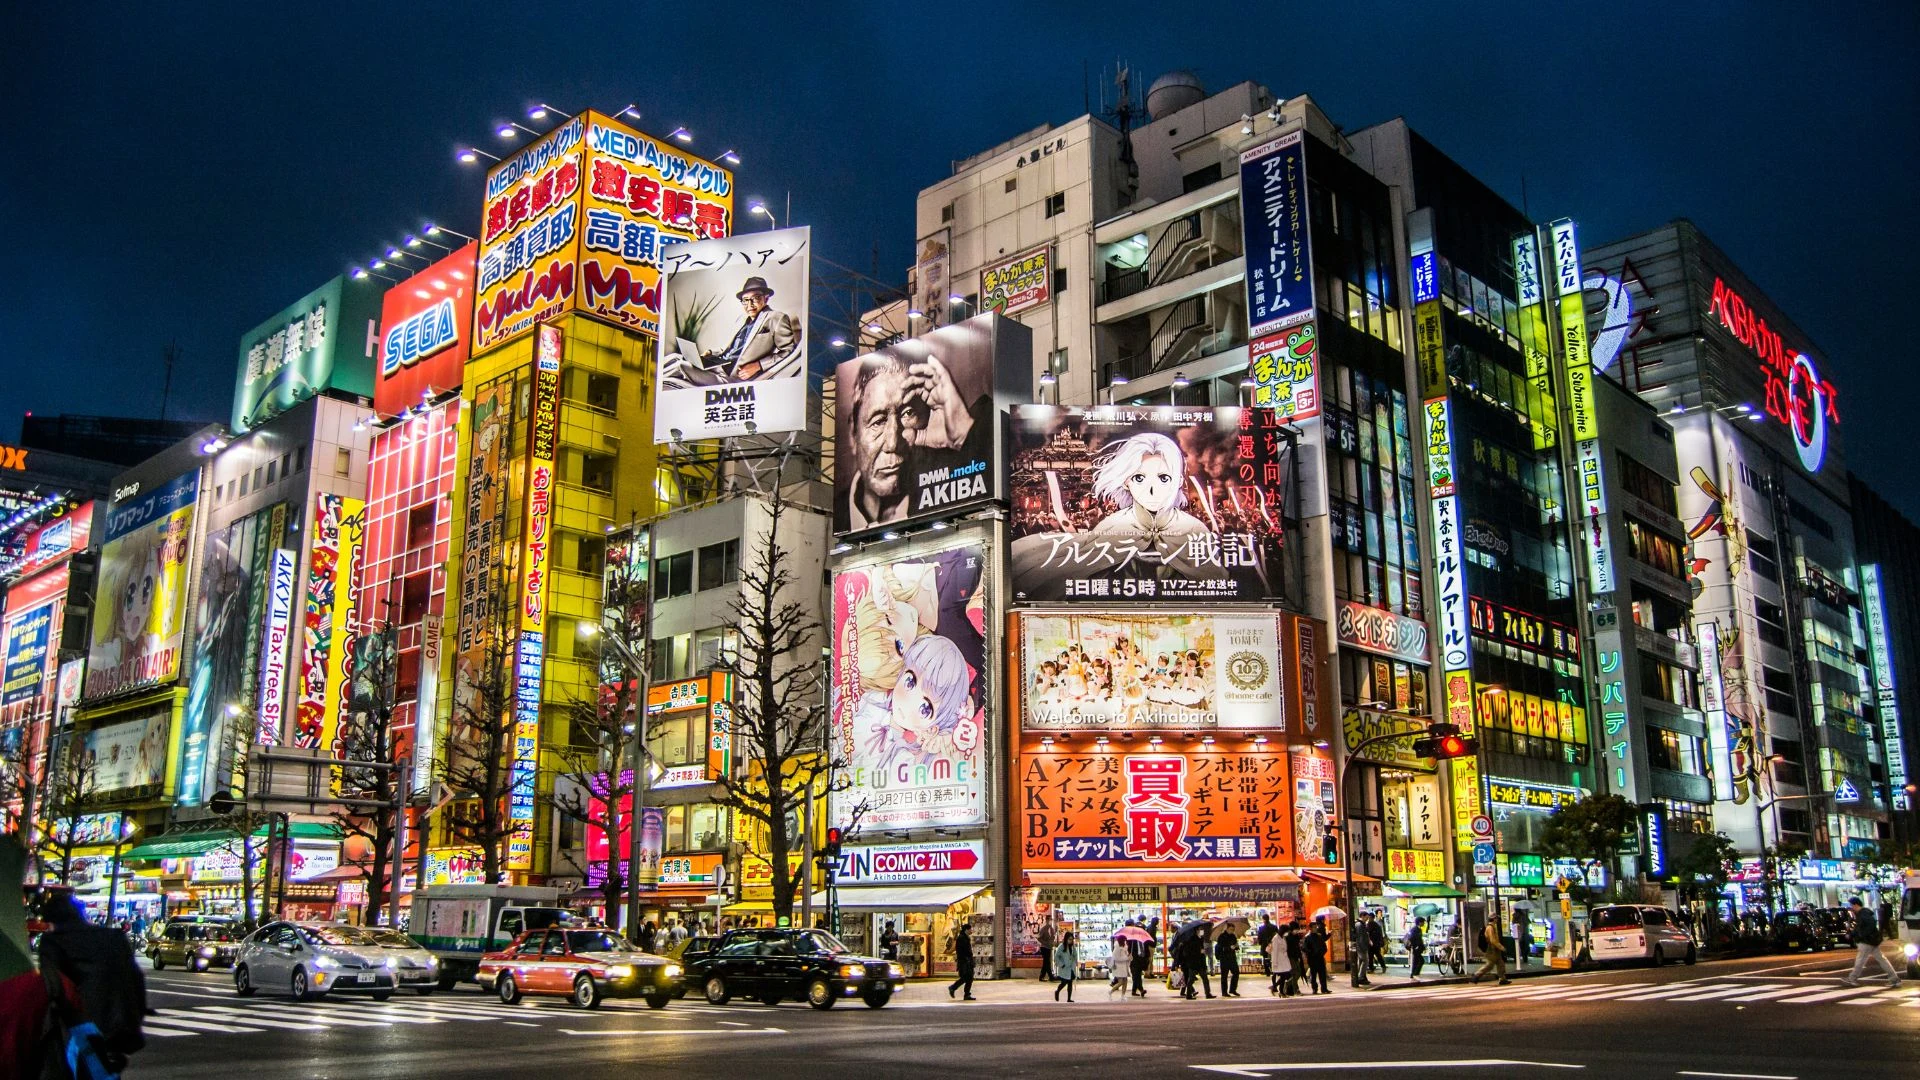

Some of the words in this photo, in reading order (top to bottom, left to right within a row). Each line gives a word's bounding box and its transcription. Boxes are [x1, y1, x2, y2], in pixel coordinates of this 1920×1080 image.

[488, 118, 584, 200] MEDIAリサイクル
[593, 124, 730, 197] MEDIAリサイクル
[1243, 145, 1271, 160] AMENITY
[1275, 134, 1298, 150] DREAM
[485, 153, 580, 243] 激安販売
[590, 159, 728, 241] 激安販売
[479, 202, 577, 295] 高額買取
[1262, 156, 1291, 312] アメニティードリーム
[985, 253, 1046, 293] まんが喫茶
[1557, 230, 1576, 288] スーパービル
[1254, 268, 1266, 317] 秋葉原店
[511, 317, 533, 334] AKIBA
[597, 304, 641, 325] ムーラン
[1254, 321, 1283, 335] AMENITY
[1287, 313, 1310, 326] DREAM
[382, 297, 459, 380] SEGA
[1566, 325, 1579, 362] Yellow
[540, 360, 558, 370] あなたの
[540, 372, 557, 384] DVD
[1253, 354, 1313, 383] まんが
[538, 391, 556, 403] ゲーム
[540, 402, 553, 411] CD
[705, 386, 755, 405] DMM
[1256, 381, 1291, 405] 喫茶
[1571, 371, 1587, 433] Submarine
[536, 420, 554, 432] アニメ
[704, 403, 755, 424] 英会話
[1173, 411, 1213, 422] 田中芳樹
[1428, 401, 1445, 445] まんが
[114, 482, 140, 503] Sofmap
[918, 473, 987, 510] AKIBA
[460, 454, 485, 652] 激安販売の専門店
[1039, 532, 1257, 572] アルスラーン戦記
[272, 552, 293, 608] AKKY
[475, 521, 493, 645] 高額買取と
[1075, 579, 1109, 596] 日曜
[1123, 578, 1156, 597] 5時
[1161, 579, 1237, 590] TVアニメ放送中
[1439, 556, 1464, 646] ルノアール
[427, 621, 440, 659] GAME
[1338, 605, 1427, 657] メイドカジノ
[1503, 611, 1545, 646] フィギュア
[263, 624, 287, 700] Tax-free
[670, 682, 698, 699] 吉野家
[1255, 692, 1272, 700] cafe
[1449, 676, 1472, 738] 免税
[1031, 708, 1107, 724] Welcome
[1111, 708, 1127, 724] to
[1133, 708, 1216, 724] Akihabara
[1600, 651, 1626, 788] リバティー
[1053, 757, 1074, 833] アイドル
[1076, 757, 1098, 813] アニメ
[1098, 757, 1120, 836] 美少女系
[1192, 757, 1214, 835] フィギュア
[1215, 757, 1236, 813] ホビー
[1237, 757, 1260, 835] 携帯電話
[1024, 758, 1051, 858] AKBもの
[1125, 757, 1190, 860] 買取
[1261, 757, 1285, 859] アップルとか
[1419, 795, 1432, 840] ルノアール
[1476, 821, 1488, 829] 40
[313, 854, 333, 862] Japan
[510, 843, 530, 851] AKIBA
[1055, 839, 1122, 859] チケット
[1194, 837, 1258, 859] 大黒屋
[1477, 848, 1486, 861] P
[1647, 812, 1660, 873] GALLERIA
[663, 858, 691, 875] 吉野家
[838, 848, 870, 880] ZIN
[873, 873, 917, 881] Akihabara
[875, 852, 926, 872] COMIC
[928, 851, 951, 870] ZIN
[1510, 861, 1542, 877] リバティー
